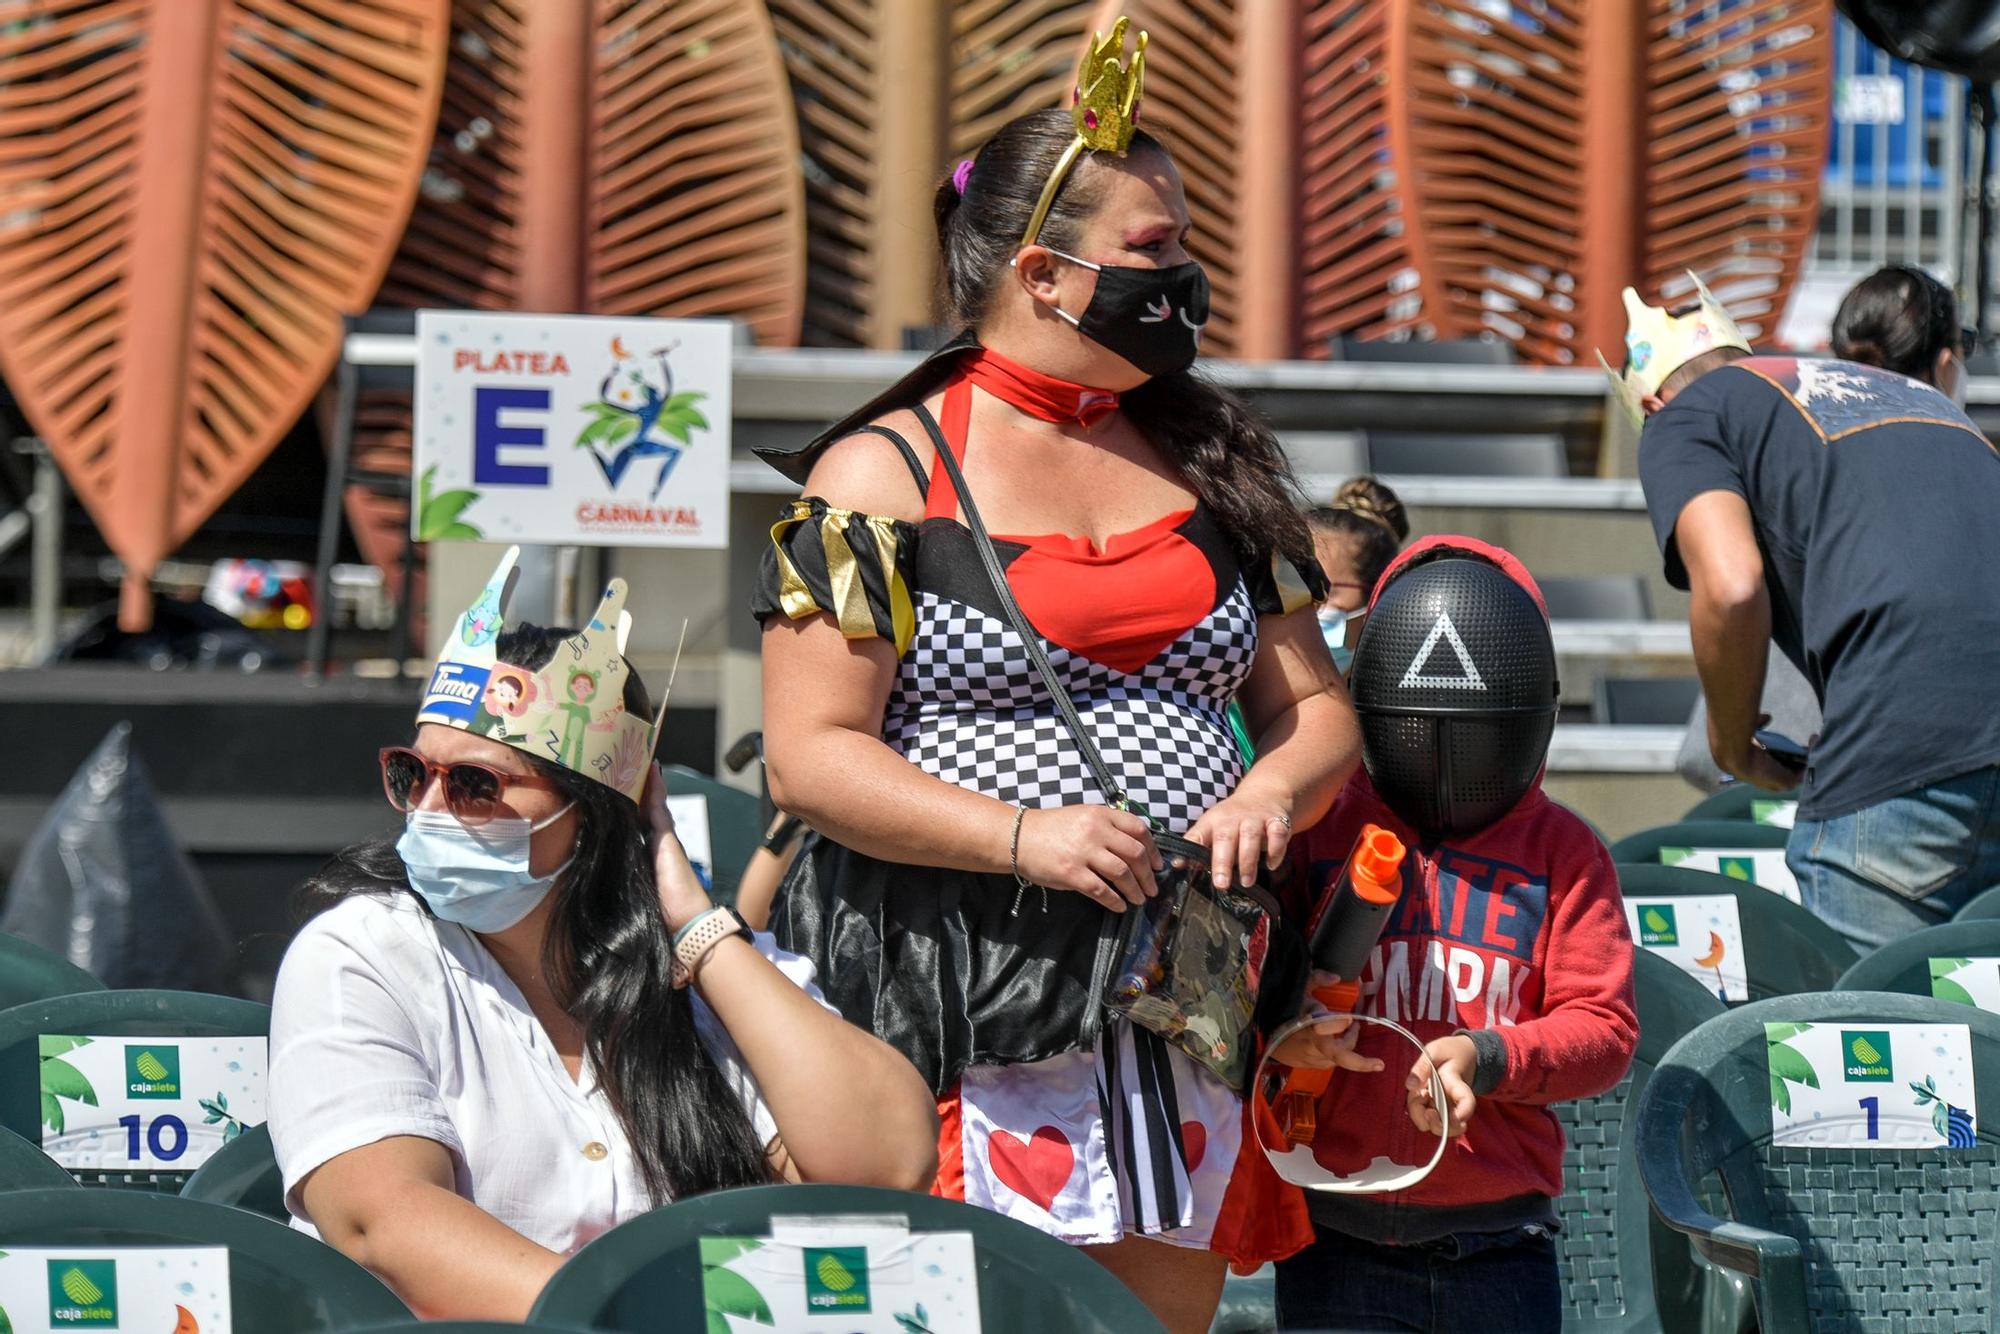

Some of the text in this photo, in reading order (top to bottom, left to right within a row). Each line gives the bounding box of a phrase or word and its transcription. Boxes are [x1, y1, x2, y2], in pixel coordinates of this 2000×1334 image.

[453, 350, 569, 376] PLATEA
[474, 386, 552, 487] E
[576, 502, 702, 526] CARNAVAL
[431, 665, 480, 700] Tirma
[1847, 1065, 1889, 1078] cajasiete
[130, 1082, 176, 1094] cajasiete
[1858, 1096, 1879, 1140] 1
[118, 1114, 188, 1162] 10
[55, 1307, 113, 1322] cajasiete
